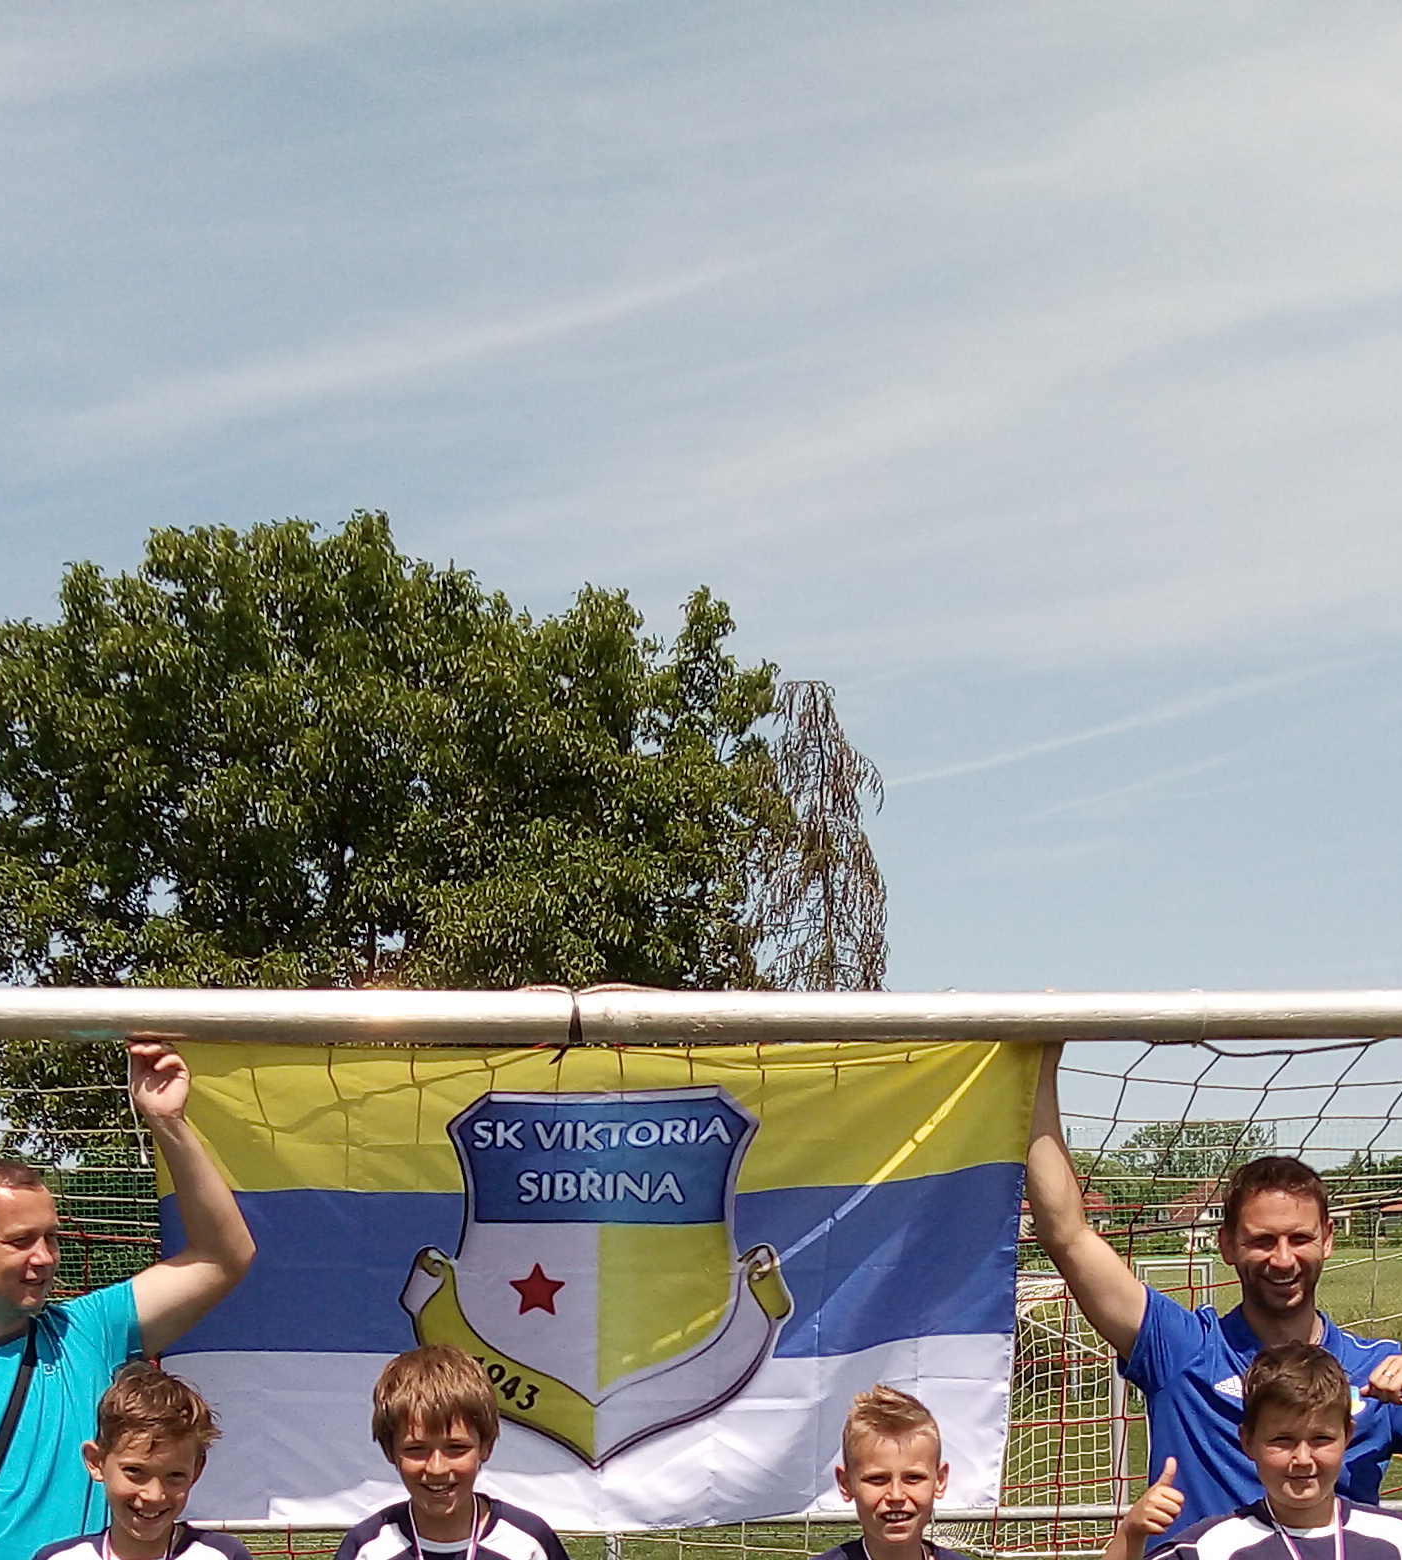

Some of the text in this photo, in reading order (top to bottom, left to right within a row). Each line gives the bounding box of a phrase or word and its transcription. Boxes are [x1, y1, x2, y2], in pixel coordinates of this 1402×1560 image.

[472, 1116, 733, 1150] SK VIKTORIA
[517, 1166, 685, 1204] SIBŘINA
[473, 1356, 540, 1410] 943
